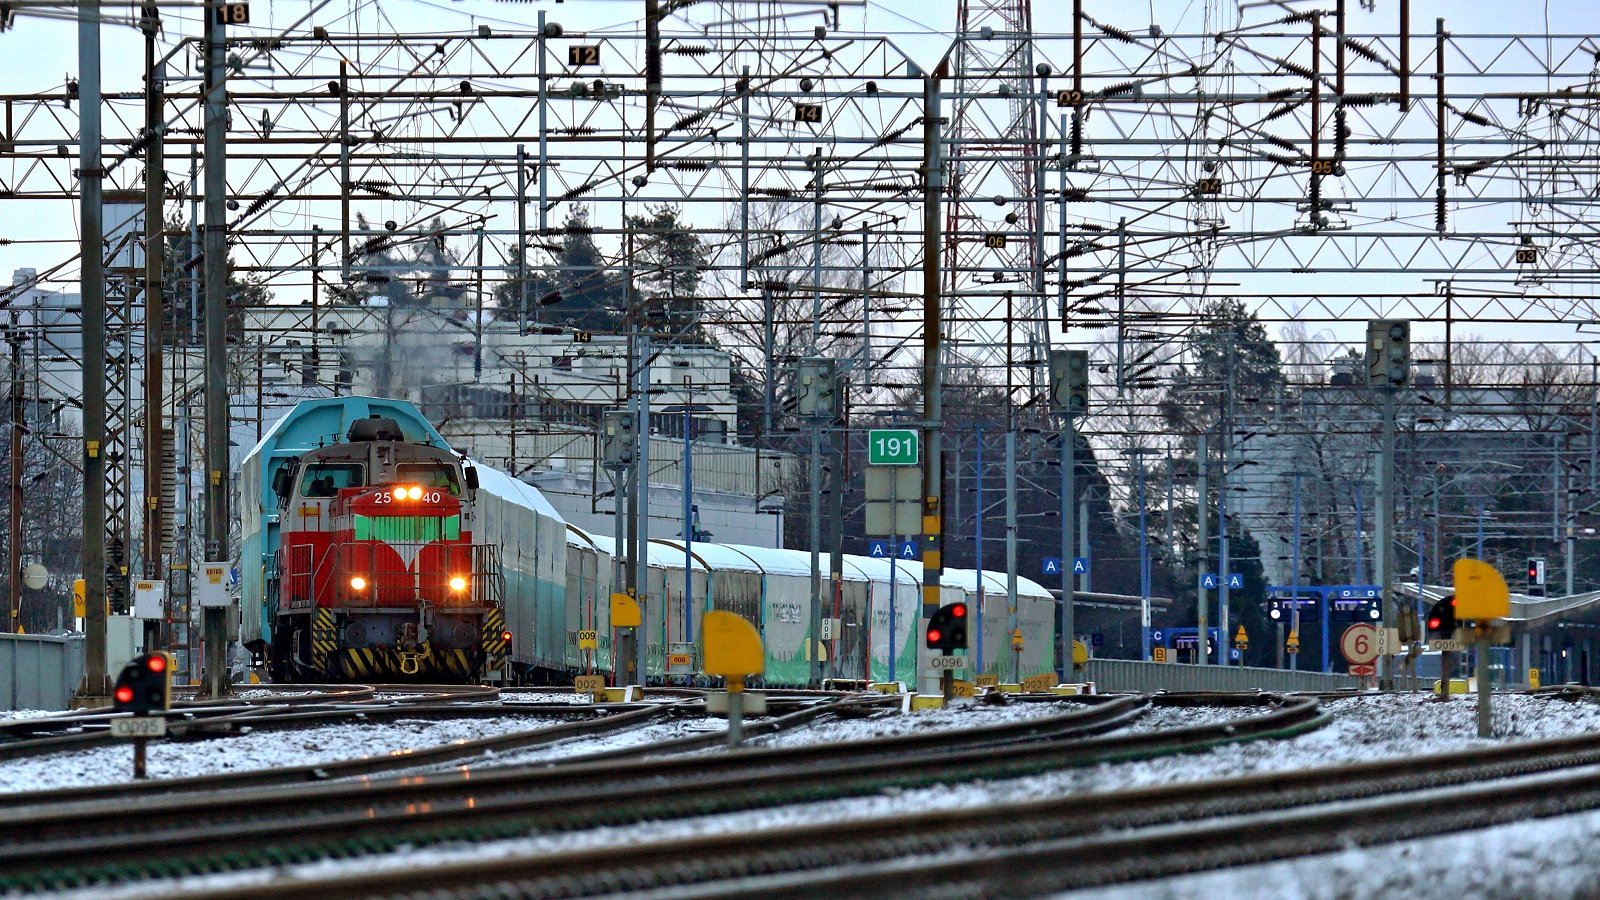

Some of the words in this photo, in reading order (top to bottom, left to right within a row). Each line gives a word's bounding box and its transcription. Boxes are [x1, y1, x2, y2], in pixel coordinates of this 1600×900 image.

[220, 4, 246, 23] 18
[572, 47, 597, 64] 12
[1059, 91, 1082, 106] 02
[798, 106, 818, 120] 14
[1313, 161, 1332, 174] 05
[989, 236, 1004, 247] 06
[1517, 250, 1535, 262] 03
[576, 332, 588, 342] 14
[876, 438, 911, 456] 191
[374, 492, 391, 504] 25
[422, 492, 440, 504] 40
[873, 544, 883, 555] A
[903, 544, 914, 555] A
[1047, 560, 1056, 571] A
[1075, 560, 1084, 571] A
[1204, 576, 1213, 586] A
[1230, 576, 1240, 586] A
[579, 632, 596, 640] 009
[1154, 631, 1162, 640] C
[1212, 630, 1218, 641] 1
[1354, 634, 1368, 655] 6
[1156, 650, 1163, 659] B
[577, 680, 596, 689] 002
[976, 677, 991, 685] 007
